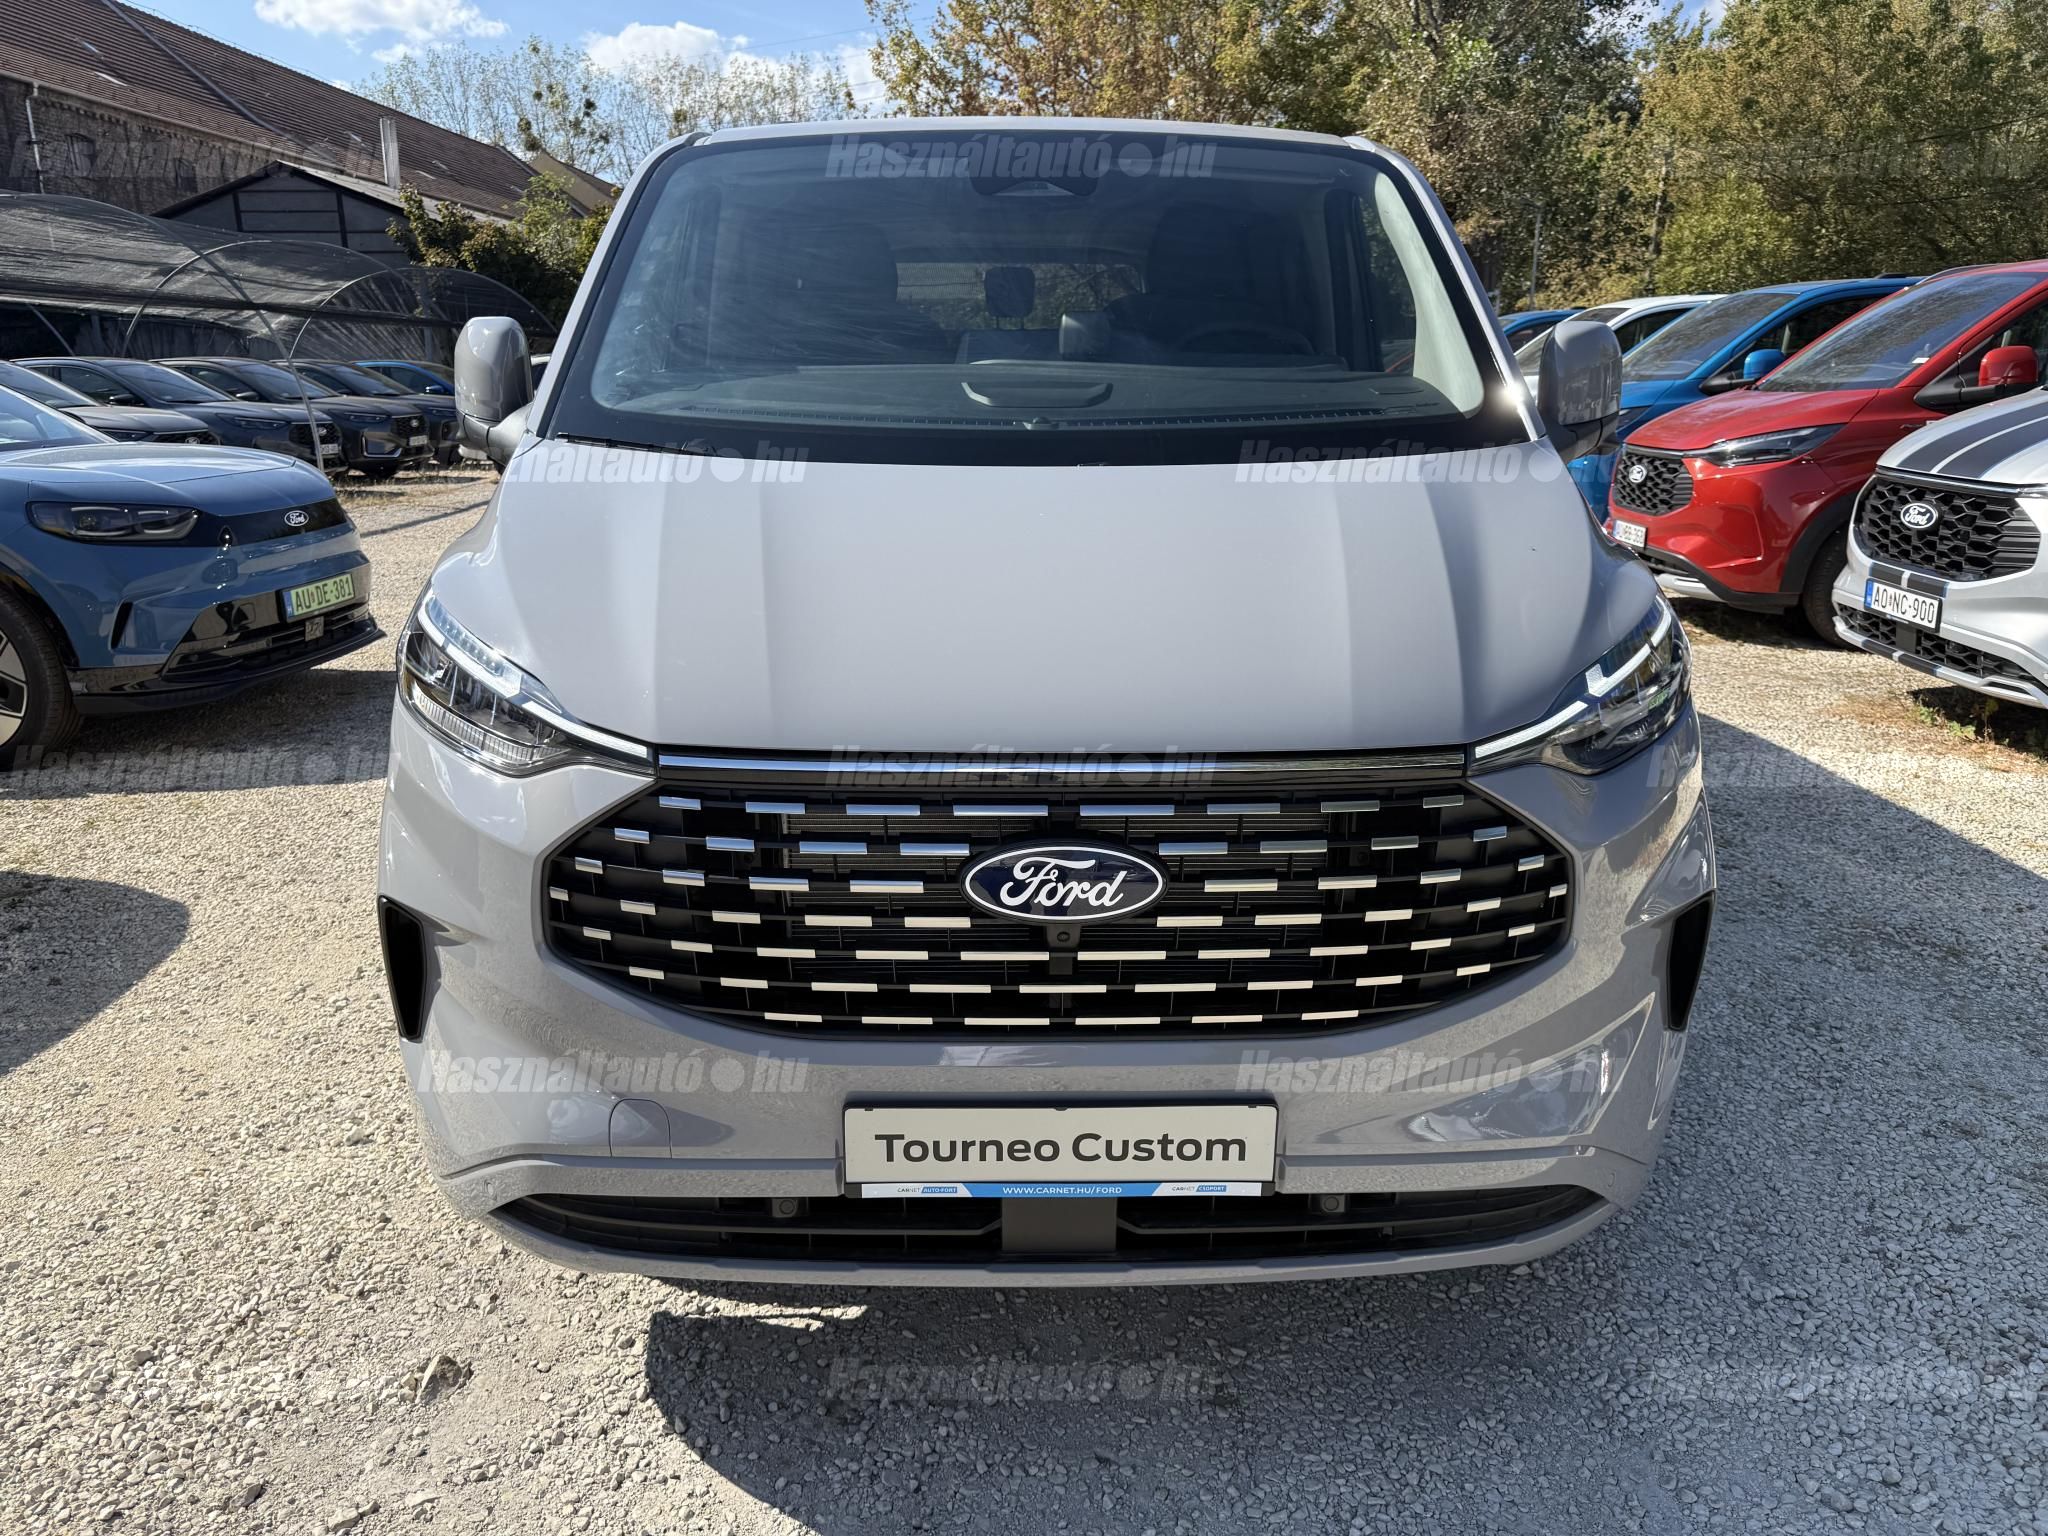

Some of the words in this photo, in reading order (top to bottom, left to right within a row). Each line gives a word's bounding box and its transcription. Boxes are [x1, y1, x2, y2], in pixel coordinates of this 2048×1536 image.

[1904, 505, 1931, 526] Ford
[999, 856, 1128, 907] Ford
[874, 1133, 1061, 1163] Tourneo
[1071, 1132, 1248, 1162] Custom
